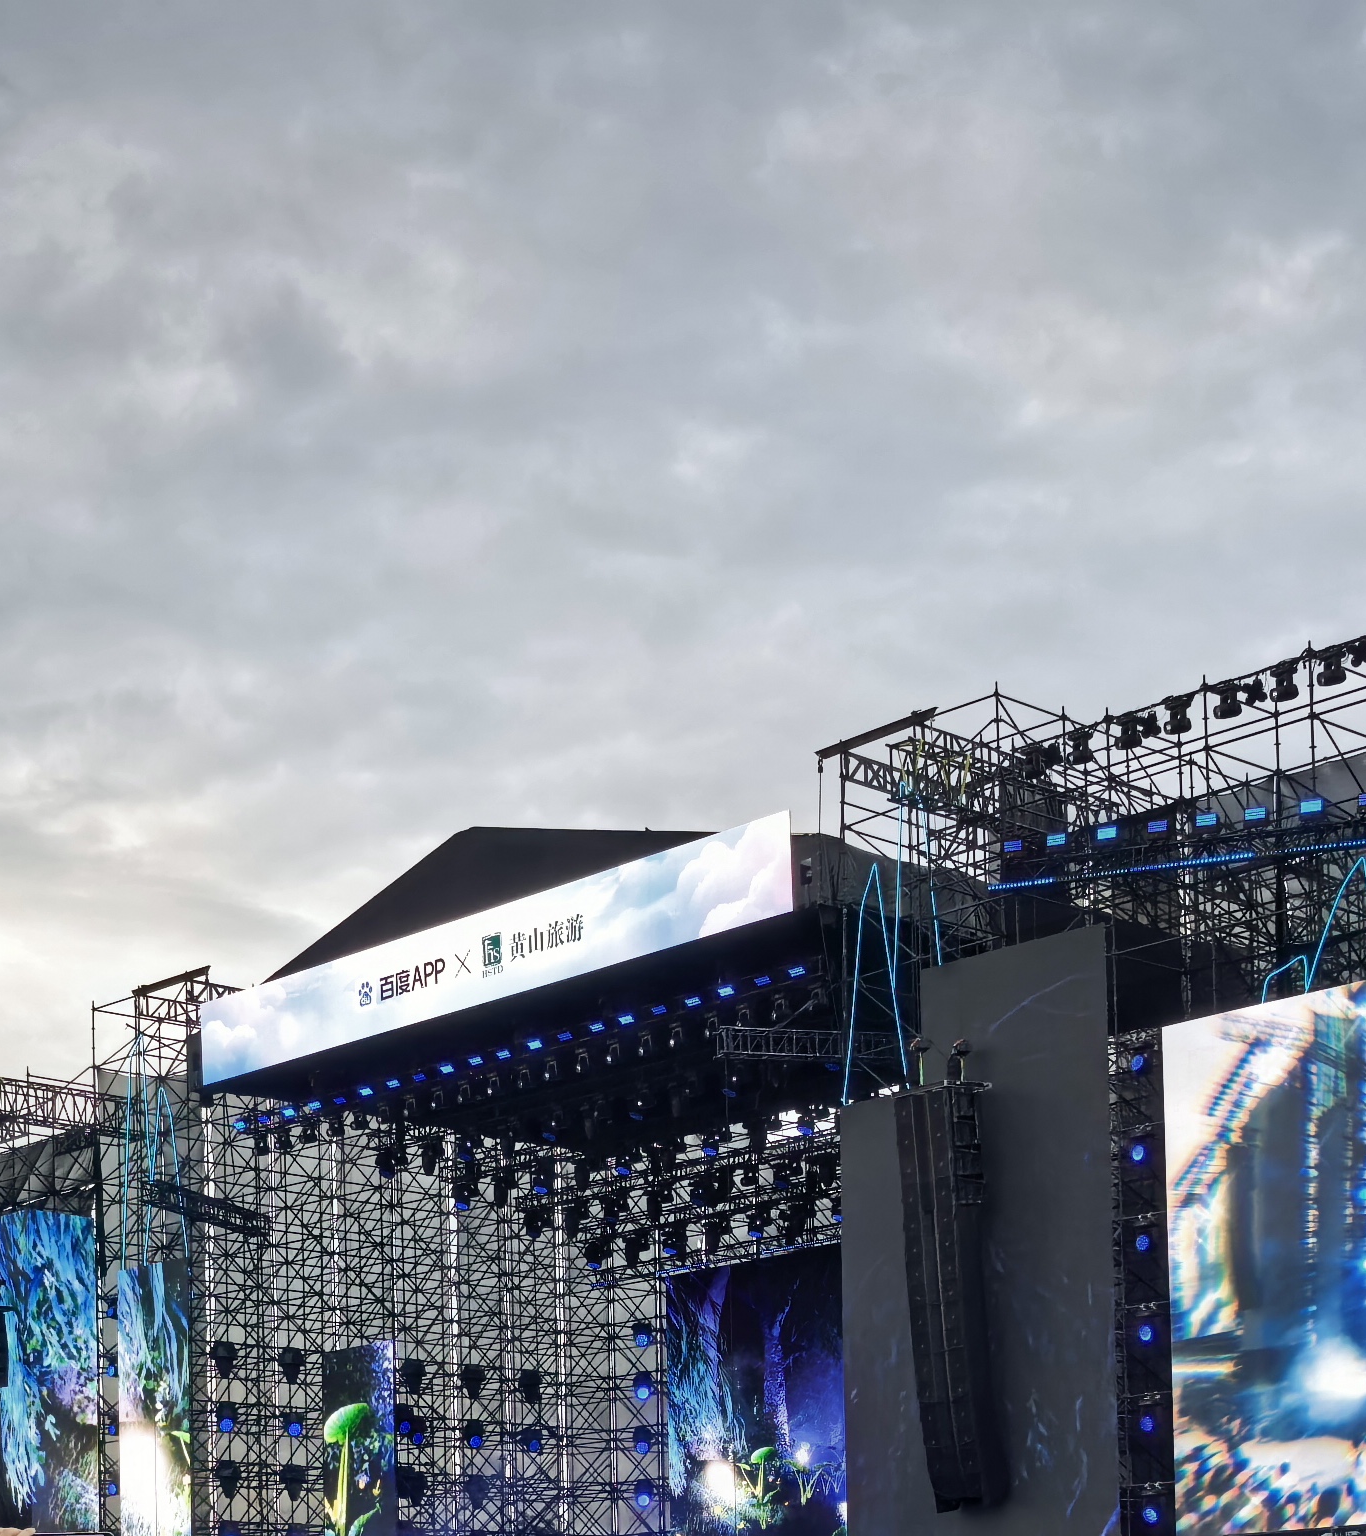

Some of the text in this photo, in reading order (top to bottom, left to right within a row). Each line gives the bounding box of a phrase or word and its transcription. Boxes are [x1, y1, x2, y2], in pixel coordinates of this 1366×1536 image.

[509, 914, 584, 962] 黄山旅游
[380, 958, 446, 1001] 百度APP
